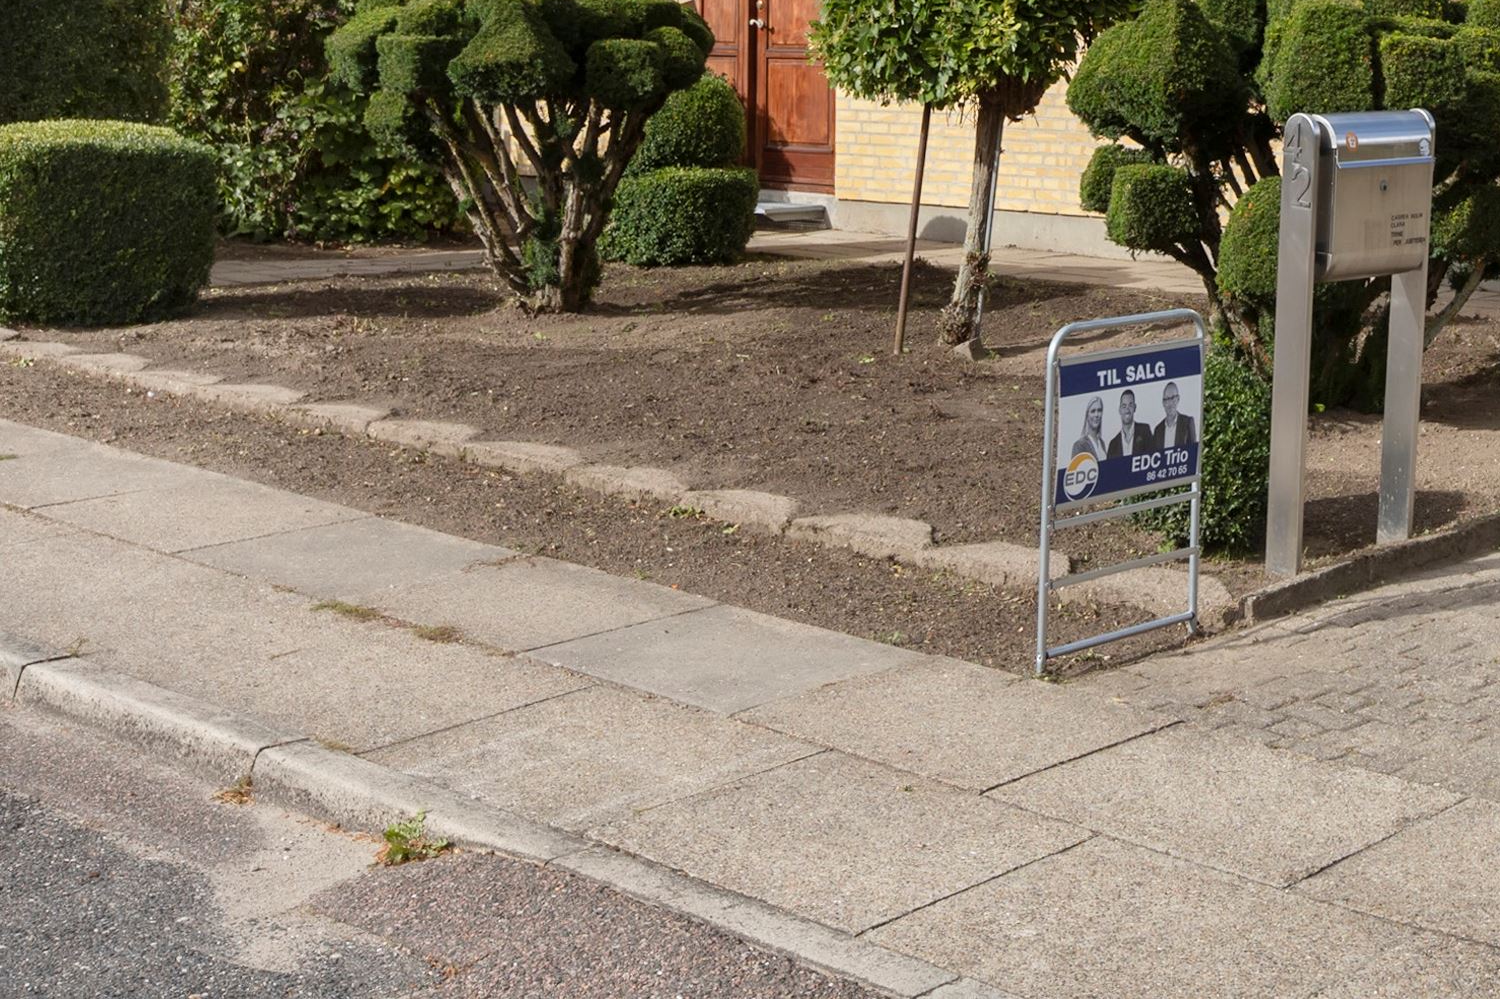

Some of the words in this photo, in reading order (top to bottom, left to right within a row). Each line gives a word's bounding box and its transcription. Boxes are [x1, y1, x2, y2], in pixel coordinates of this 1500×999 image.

[1284, 121, 1313, 209] 42
[1097, 369, 1121, 387] TIL
[1126, 361, 1166, 382] SALG
[1132, 452, 1160, 472] EDC
[1165, 448, 1188, 465] Trio
[1065, 468, 1097, 487] EDC
[1146, 471, 1156, 481] 86
[1157, 469, 1166, 479] 42
[1168, 468, 1177, 477] 70
[1178, 465, 1187, 475] 65
